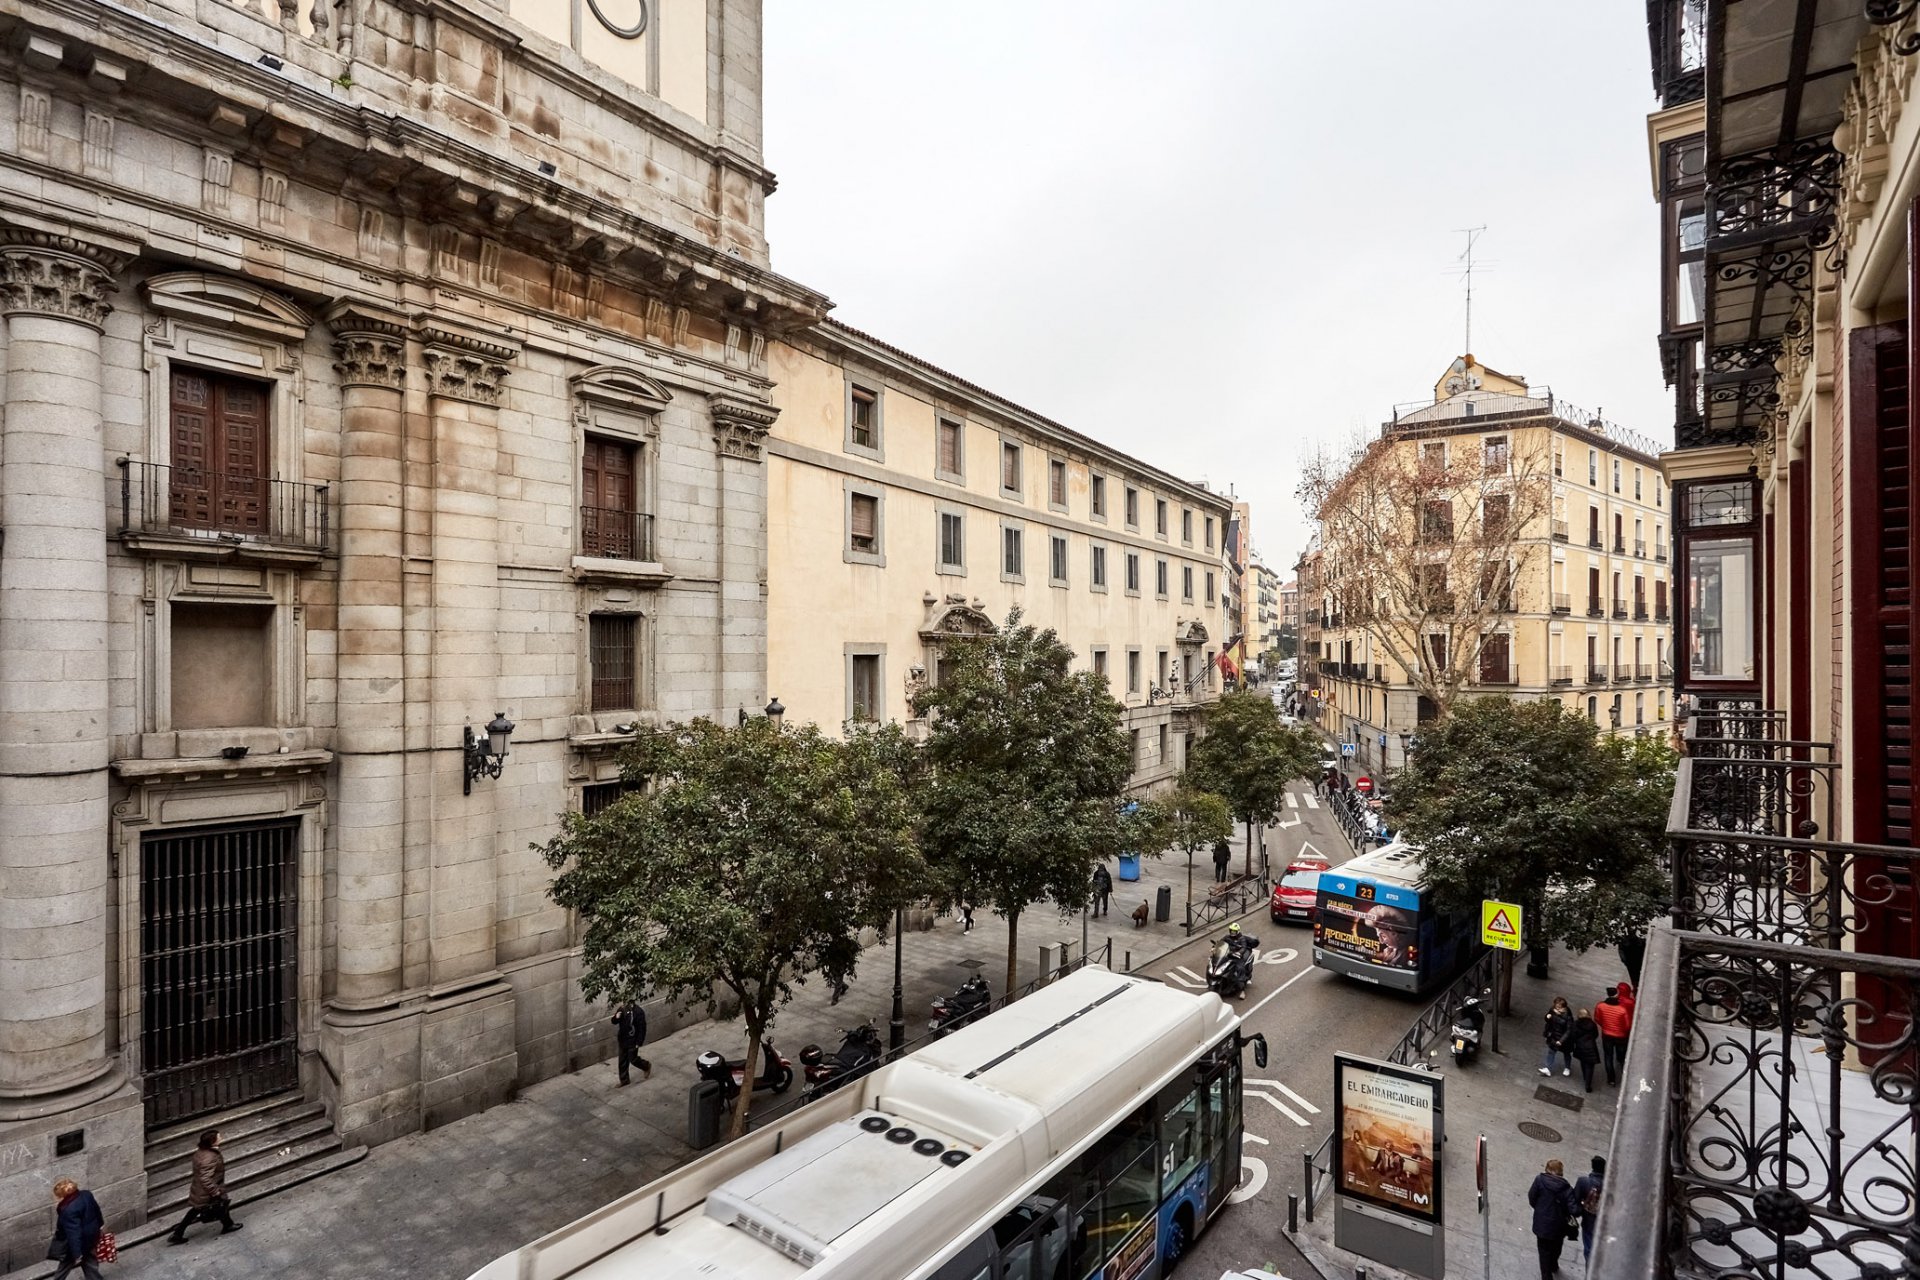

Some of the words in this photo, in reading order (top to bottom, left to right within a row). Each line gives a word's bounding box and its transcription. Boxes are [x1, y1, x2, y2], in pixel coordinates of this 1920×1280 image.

[1361, 887, 1373, 899] 23
[1323, 927, 1380, 952] APOCALIPSIS
[1486, 934, 1516, 944] RECUERDE
[1347, 1080, 1358, 1092] EL
[1361, 1083, 1429, 1109] EMBARCADERO
